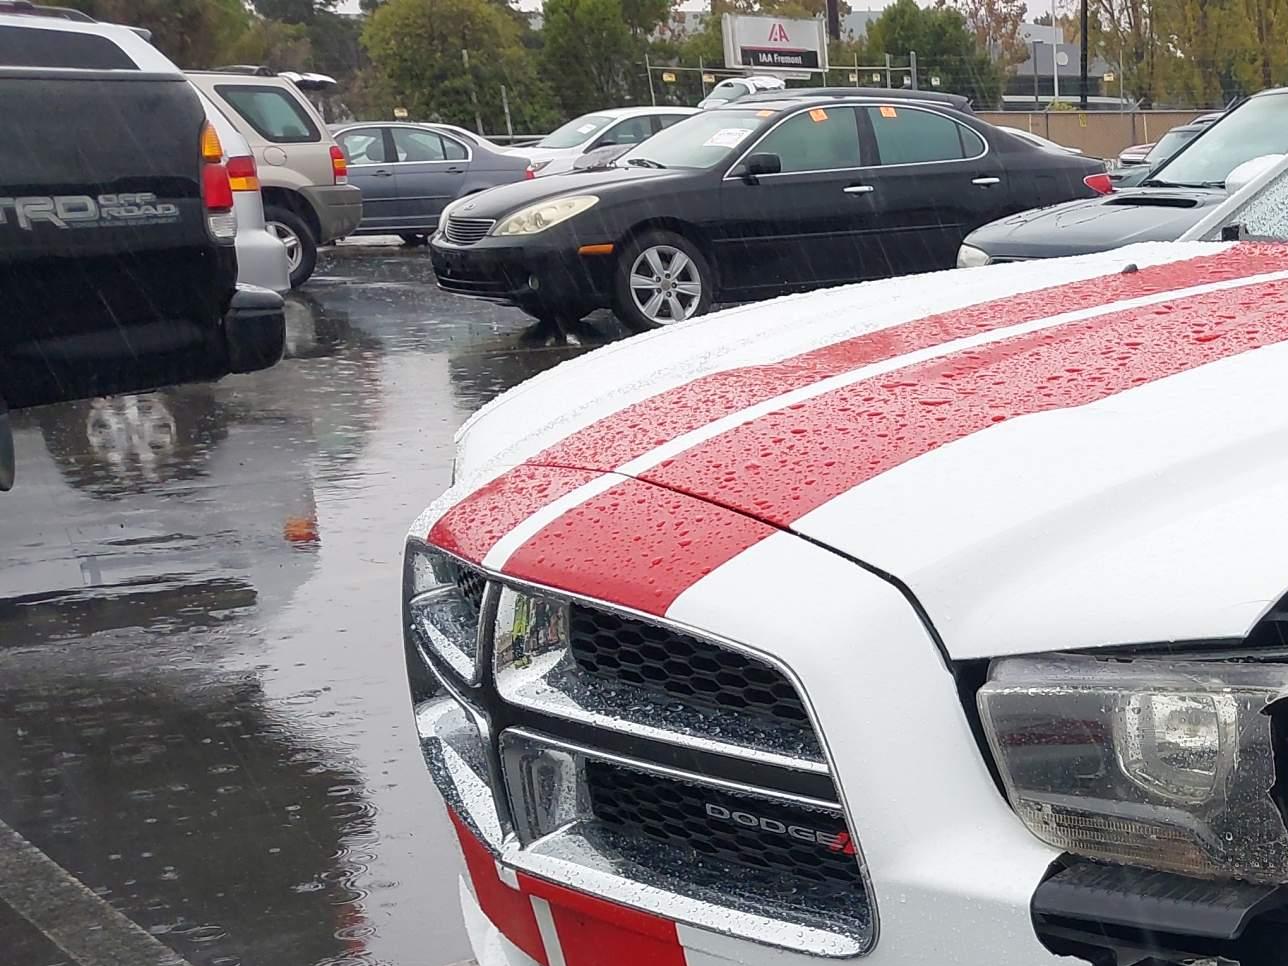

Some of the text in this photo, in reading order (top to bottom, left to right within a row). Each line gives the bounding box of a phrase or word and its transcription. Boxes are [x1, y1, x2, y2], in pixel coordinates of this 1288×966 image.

[759, 53, 802, 65] IAA Fremont
[98, 192, 157, 206] OFF
[100, 203, 180, 219] ROAD
[705, 802, 845, 849] DODGE
